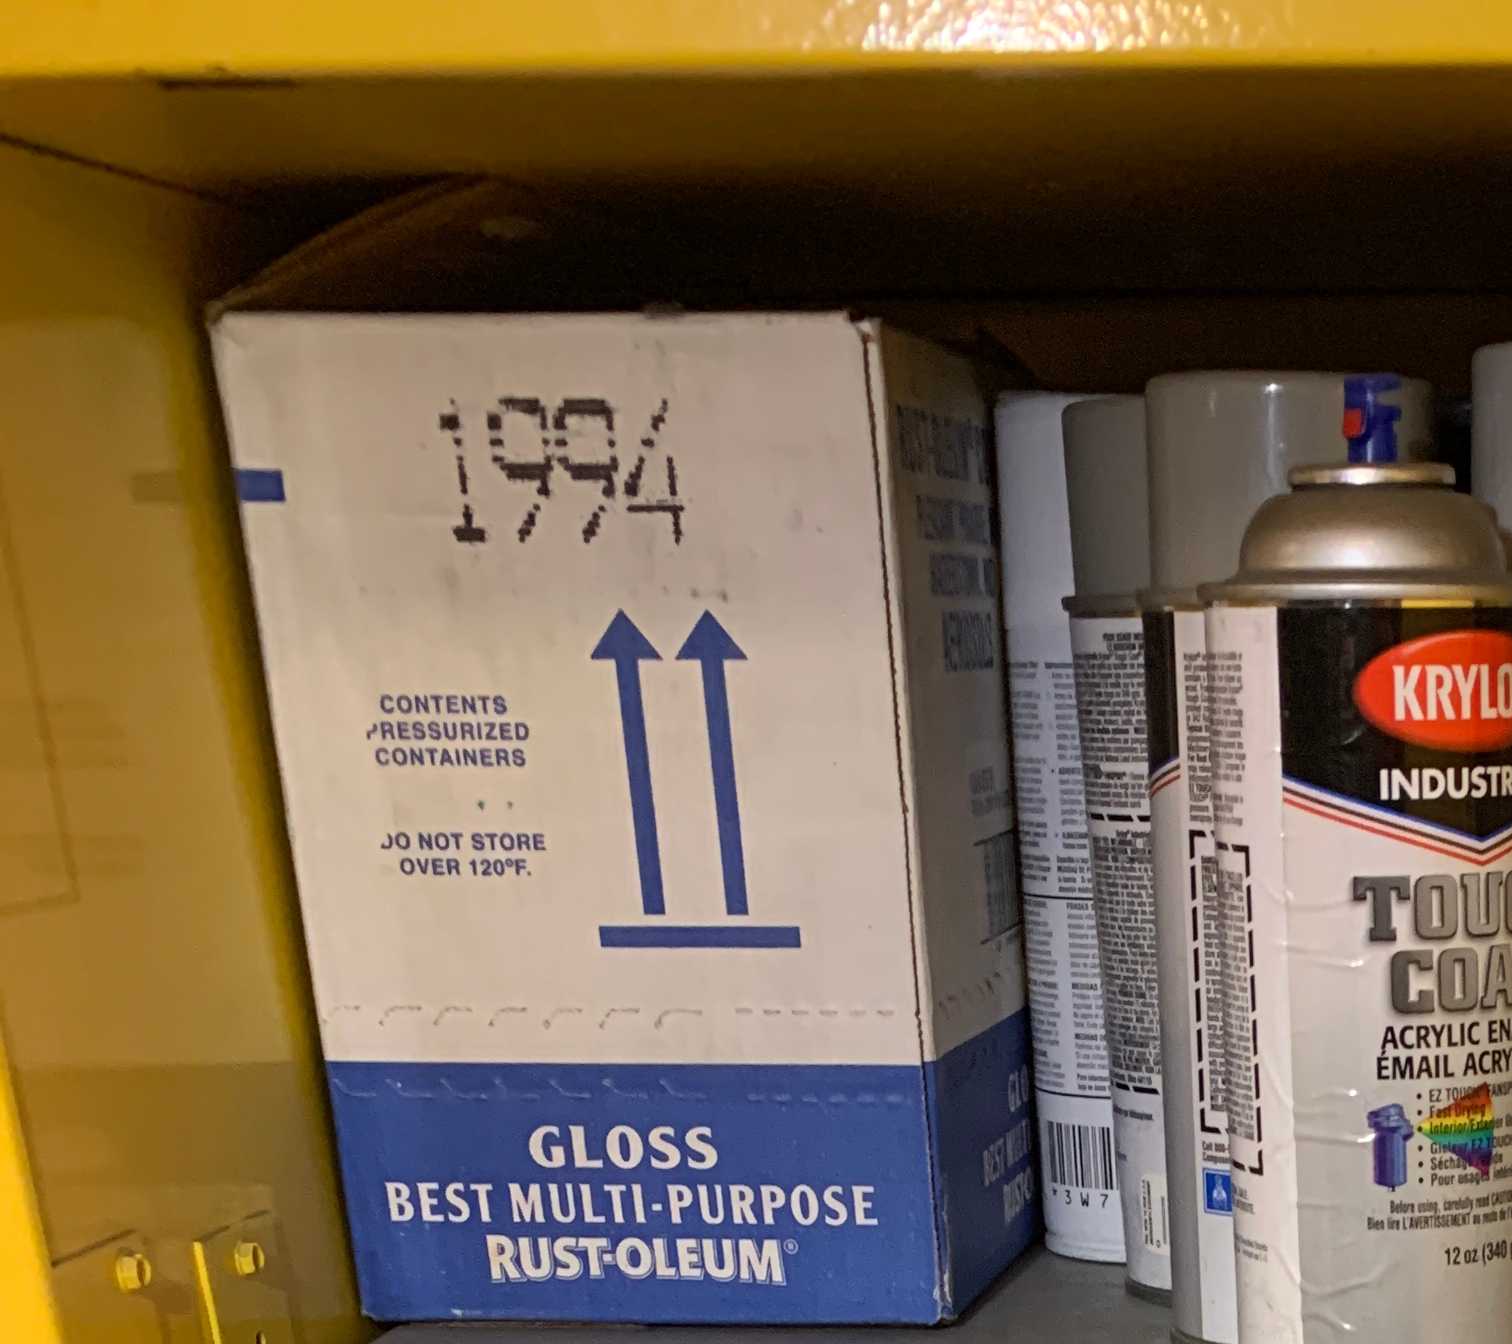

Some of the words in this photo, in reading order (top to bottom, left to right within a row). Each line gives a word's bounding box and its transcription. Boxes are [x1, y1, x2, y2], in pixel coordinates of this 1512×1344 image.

[439, 397, 685, 546] 1994
[379, 694, 508, 714] CONTENTS
[375, 747, 526, 767] CONTAINERS
[418, 832, 462, 851] NOT
[471, 833, 546, 851] STORE
[400, 857, 461, 876] OVER
[1381, 1022, 1480, 1050] ACRYLIC
[1377, 1051, 1454, 1080] ÉMAIL
[528, 1125, 718, 1170] GLOSS
[388, 1182, 494, 1224] BEST
[507, 1183, 879, 1226] MULTI-PURPOSE
[1445, 1248, 1461, 1266] 12
[1464, 1250, 1478, 1264] oz
[1482, 1242, 1506, 1266] (340
